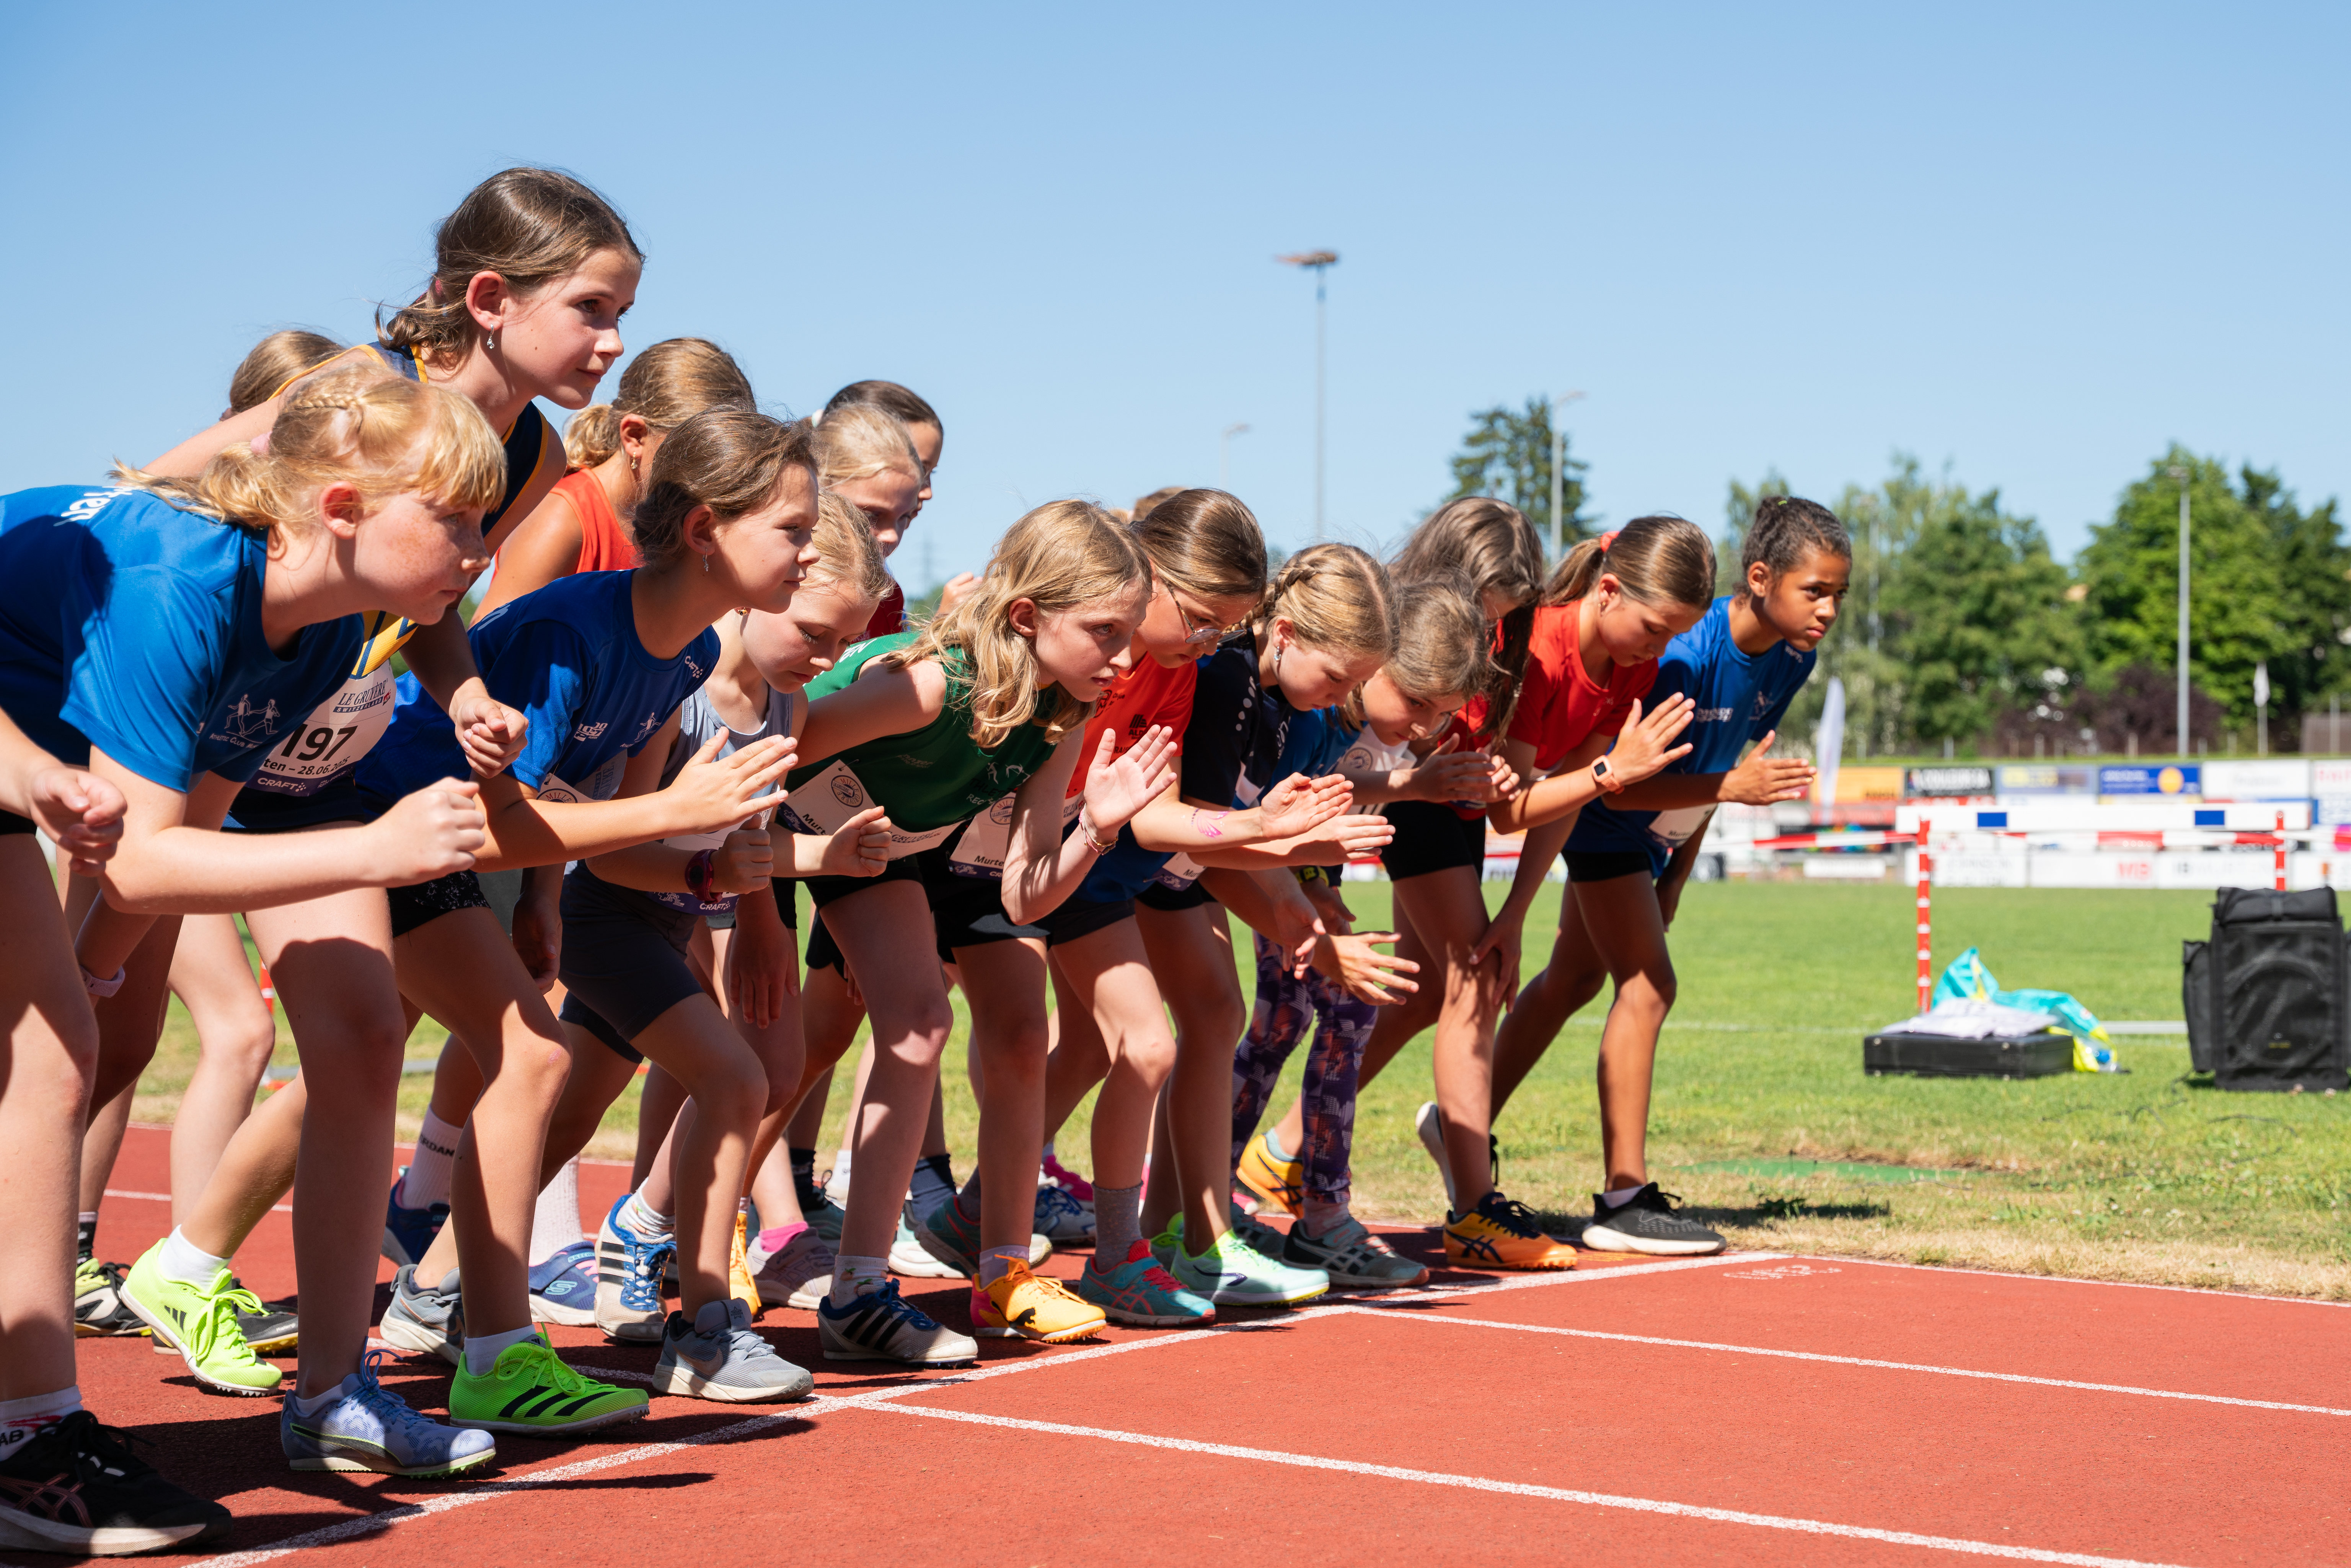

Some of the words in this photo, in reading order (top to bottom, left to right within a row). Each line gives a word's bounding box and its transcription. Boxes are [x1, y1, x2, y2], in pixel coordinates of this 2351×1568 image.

[337, 693, 356, 705] LE
[354, 680, 386, 705] GRUYÈRE
[336, 698, 382, 712] SWITZERLAND
[280, 723, 358, 761] 197
[297, 756, 351, 775] 28.06.2025
[257, 777, 298, 790] CRAFT
[545, 792, 572, 803] MILLE
[699, 903, 726, 911] CRAFT
